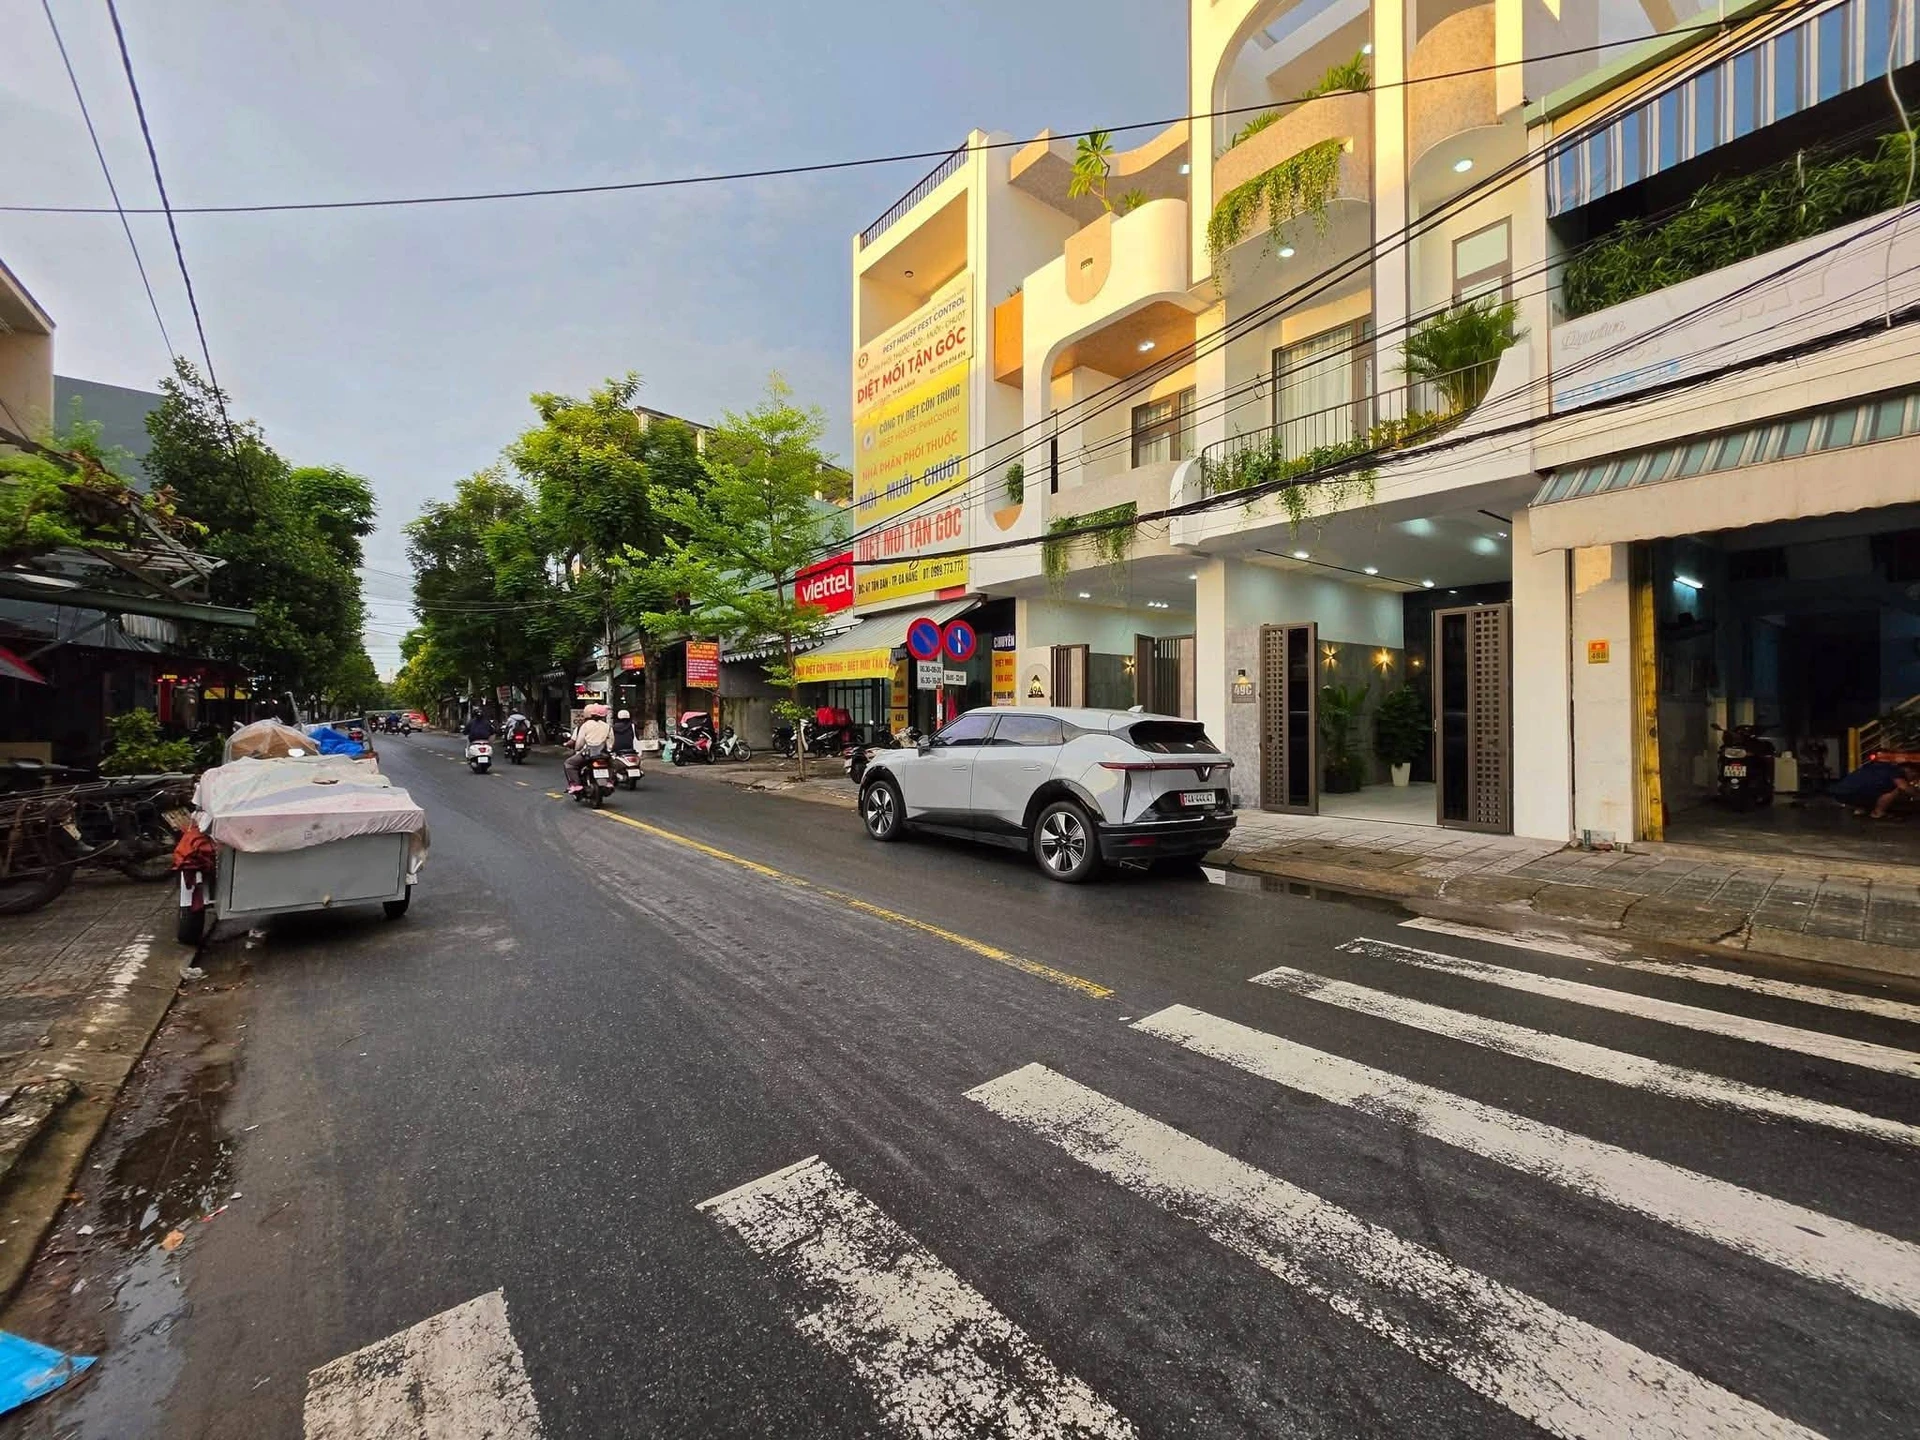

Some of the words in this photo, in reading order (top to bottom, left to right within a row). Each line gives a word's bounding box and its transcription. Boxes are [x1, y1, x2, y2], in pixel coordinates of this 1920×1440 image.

[933, 295, 966, 322] CONTROL
[857, 377, 880, 404] DIỆT
[882, 359, 905, 389] MỐI
[907, 346, 933, 374] TẬN
[935, 326, 966, 357] GỐC
[879, 418, 896, 435] CÔNG
[896, 414, 905, 428] TY
[905, 403, 920, 422] DIỆT
[920, 396, 935, 414] CÔN
[936, 384, 960, 405] TRÙNG
[861, 464, 878, 483] NHÀ
[879, 453, 902, 474] PHÂN
[926, 428, 958, 456] THUỐC
[924, 453, 962, 488] CHUỘT
[802, 568, 852, 602] viettel
[993, 632, 1015, 648] CHUYÊN
[1029, 686, 1043, 696] 49A
[1233, 684, 1253, 696] 49C
